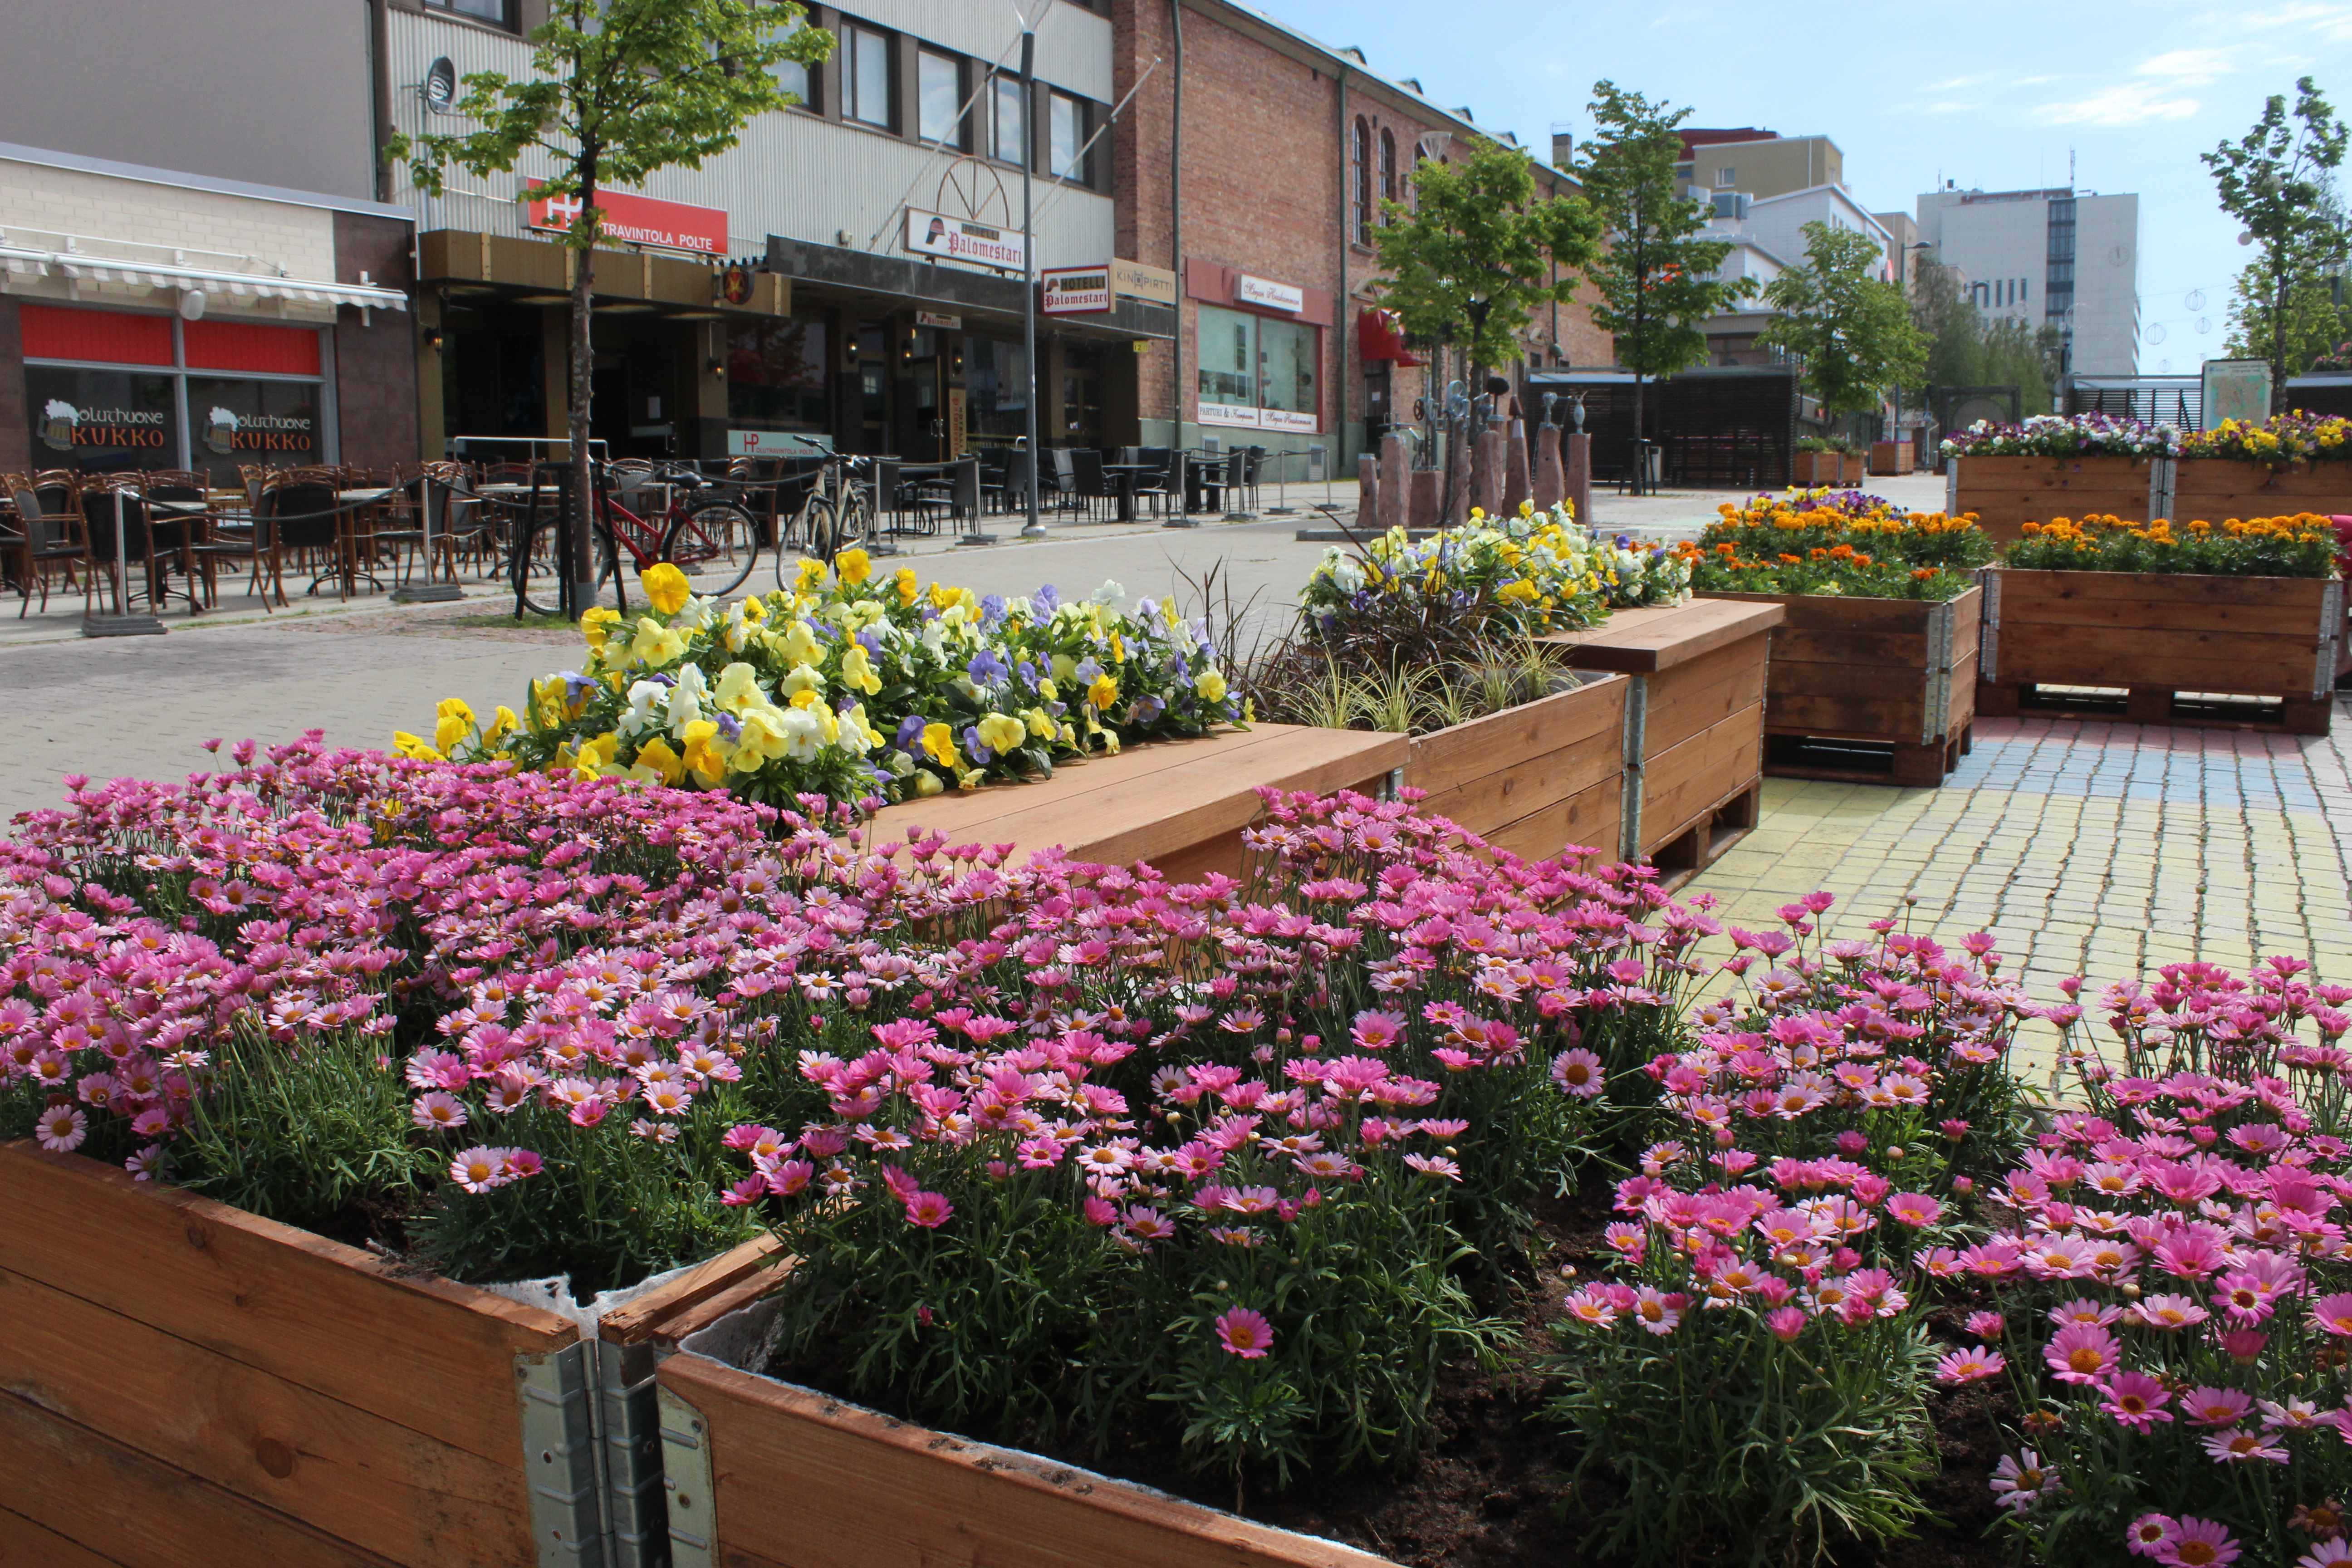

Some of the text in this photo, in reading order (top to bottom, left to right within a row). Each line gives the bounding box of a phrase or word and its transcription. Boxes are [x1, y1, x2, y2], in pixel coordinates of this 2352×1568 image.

[679, 233, 713, 251] POLTE
[948, 231, 1022, 264] Palomestari
[1061, 276, 1106, 291] HOTELLI
[1045, 293, 1107, 308] Palomestari
[1199, 407, 1222, 417] PARTURI
[71, 426, 164, 447] KUKKO
[230, 431, 310, 451] KUKKO
[744, 433, 760, 453] HP
